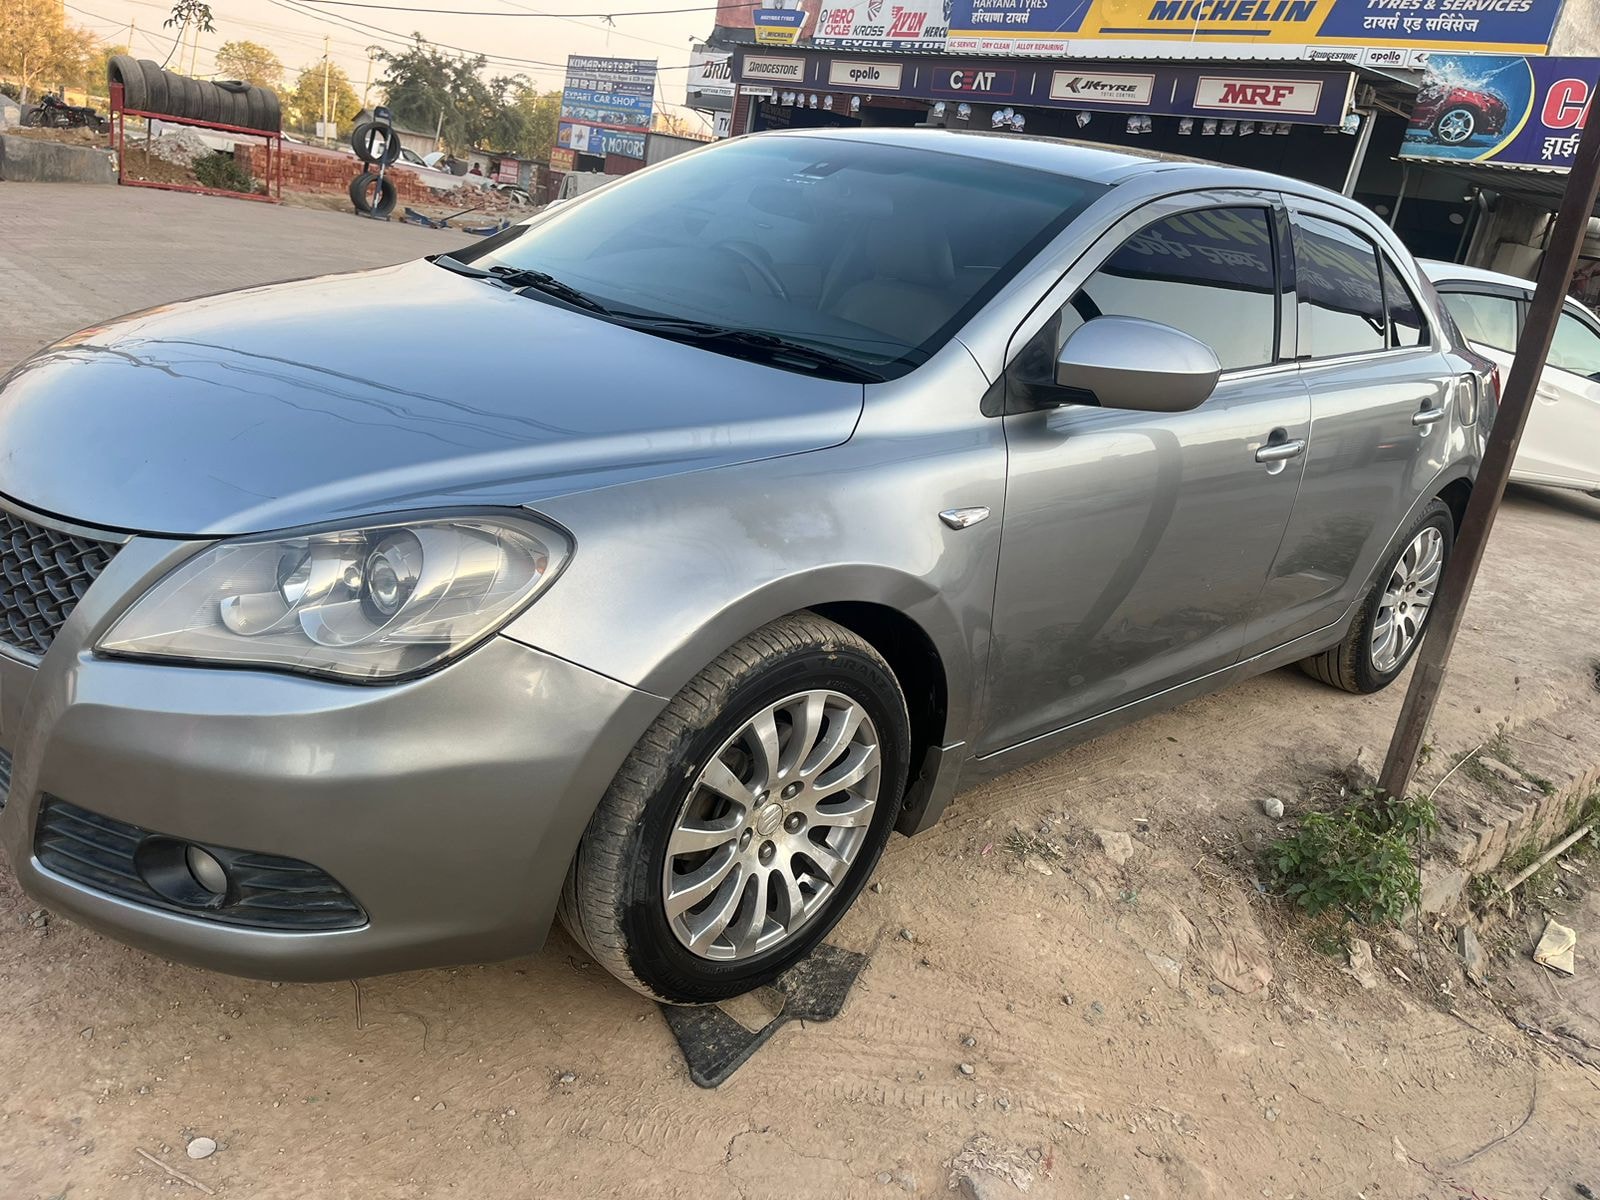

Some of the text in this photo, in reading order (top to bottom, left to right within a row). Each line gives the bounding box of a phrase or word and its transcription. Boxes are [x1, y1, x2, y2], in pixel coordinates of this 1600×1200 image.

[973, 0, 1048, 8] HARYANA TYRES
[1366, 0, 1534, 12] TYRES & SERVICES
[827, 9, 855, 24] HERO
[971, 9, 1031, 25] हरियाणा टायर्स
[1147, 0, 1318, 22] MICHELIN
[886, 6, 927, 38] AVON
[1363, 12, 1479, 33] टायर्स एंड सर्विसेज
[824, 24, 851, 36] CYCLES
[852, 25, 885, 37] KROSS
[841, 39, 893, 48] CYCLE
[993, 42, 1010, 50] CLEAN
[1016, 43, 1064, 51] ALLOY REPAIRING
[1309, 50, 1358, 60] BRIDGESTONE
[1370, 51, 1400, 62] apollo
[748, 61, 799, 75] BRIDGESTONE
[850, 67, 880, 81] apollo
[950, 70, 996, 91] CEAT
[593, 94, 610, 103] CAR
[612, 96, 636, 106] SHOP
[1218, 83, 1294, 107] MRF
[608, 137, 644, 156] MOTORS
